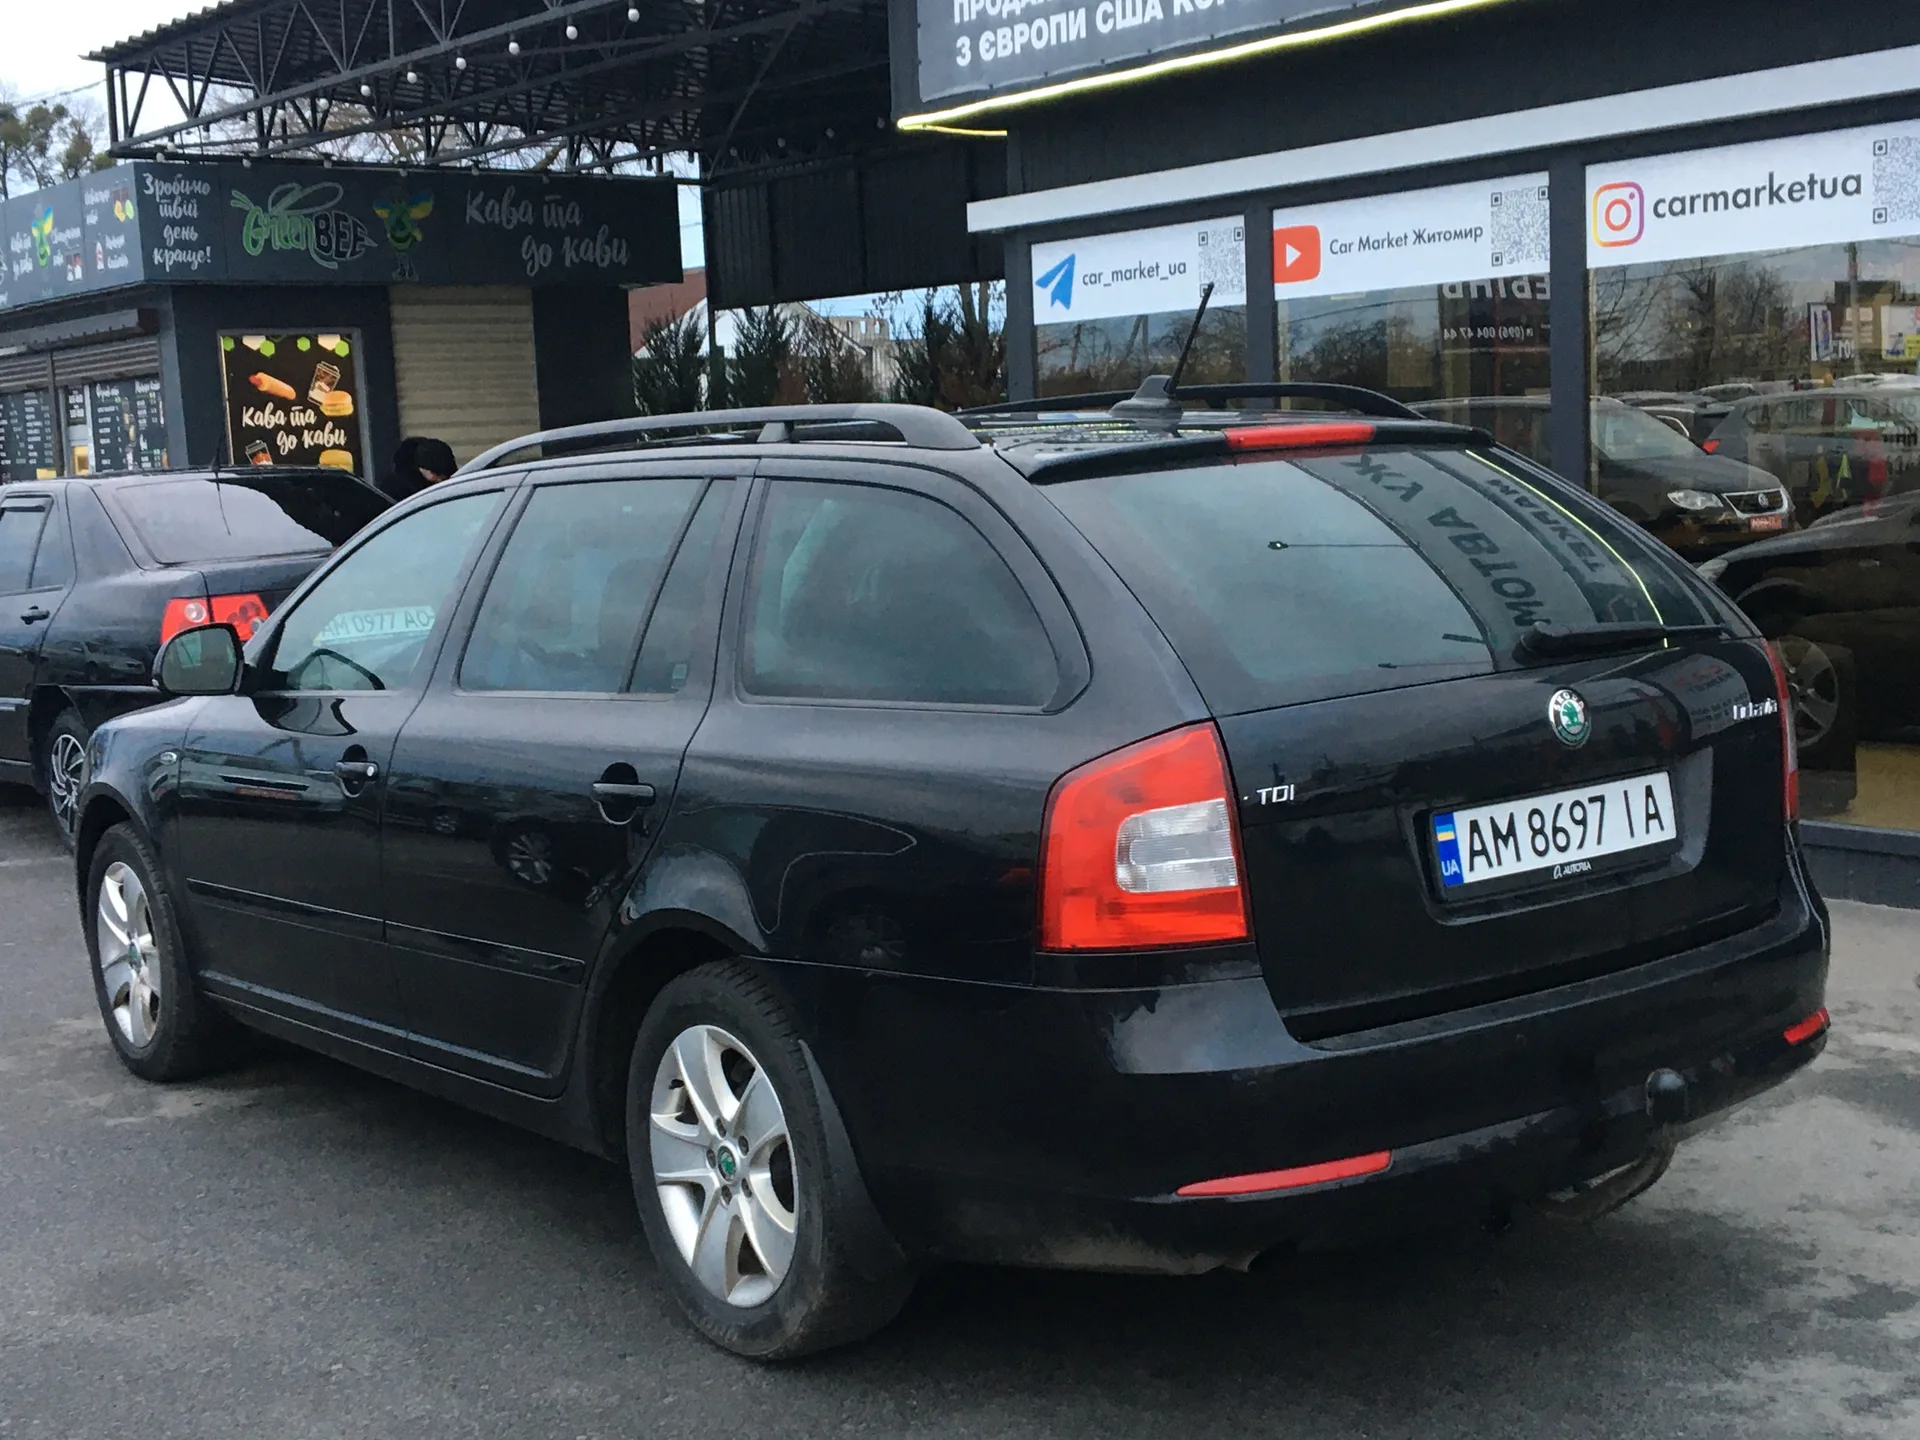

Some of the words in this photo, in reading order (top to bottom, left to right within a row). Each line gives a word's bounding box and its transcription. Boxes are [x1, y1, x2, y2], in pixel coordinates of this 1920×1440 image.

[956, 35, 972, 67] З
[978, 7, 1087, 62] ЄВРОПИ
[1095, 0, 1164, 34] США
[143, 173, 211, 200] Зробимо
[1652, 171, 1862, 219] carmarketua
[158, 197, 198, 220] твій
[465, 185, 534, 230] Кава
[543, 194, 583, 229] та
[163, 224, 199, 246] день
[1329, 237, 1355, 255] Car
[1358, 232, 1408, 252] Market
[1412, 225, 1484, 244] Житомир
[153, 246, 212, 272] краще!
[521, 234, 553, 277] до
[561, 224, 629, 268] кави
[1082, 259, 1187, 287] car_market_ua
[242, 402, 287, 429] Кава
[290, 405, 317, 427] та
[276, 430, 298, 455] до
[302, 421, 347, 448] кави
[352, 611, 395, 633] 0977
[1256, 784, 1295, 805] TDI
[1468, 811, 1522, 873] AM
[1528, 794, 1605, 857] 8697
[1624, 784, 1665, 838] IA
[1442, 860, 1460, 877] UA
